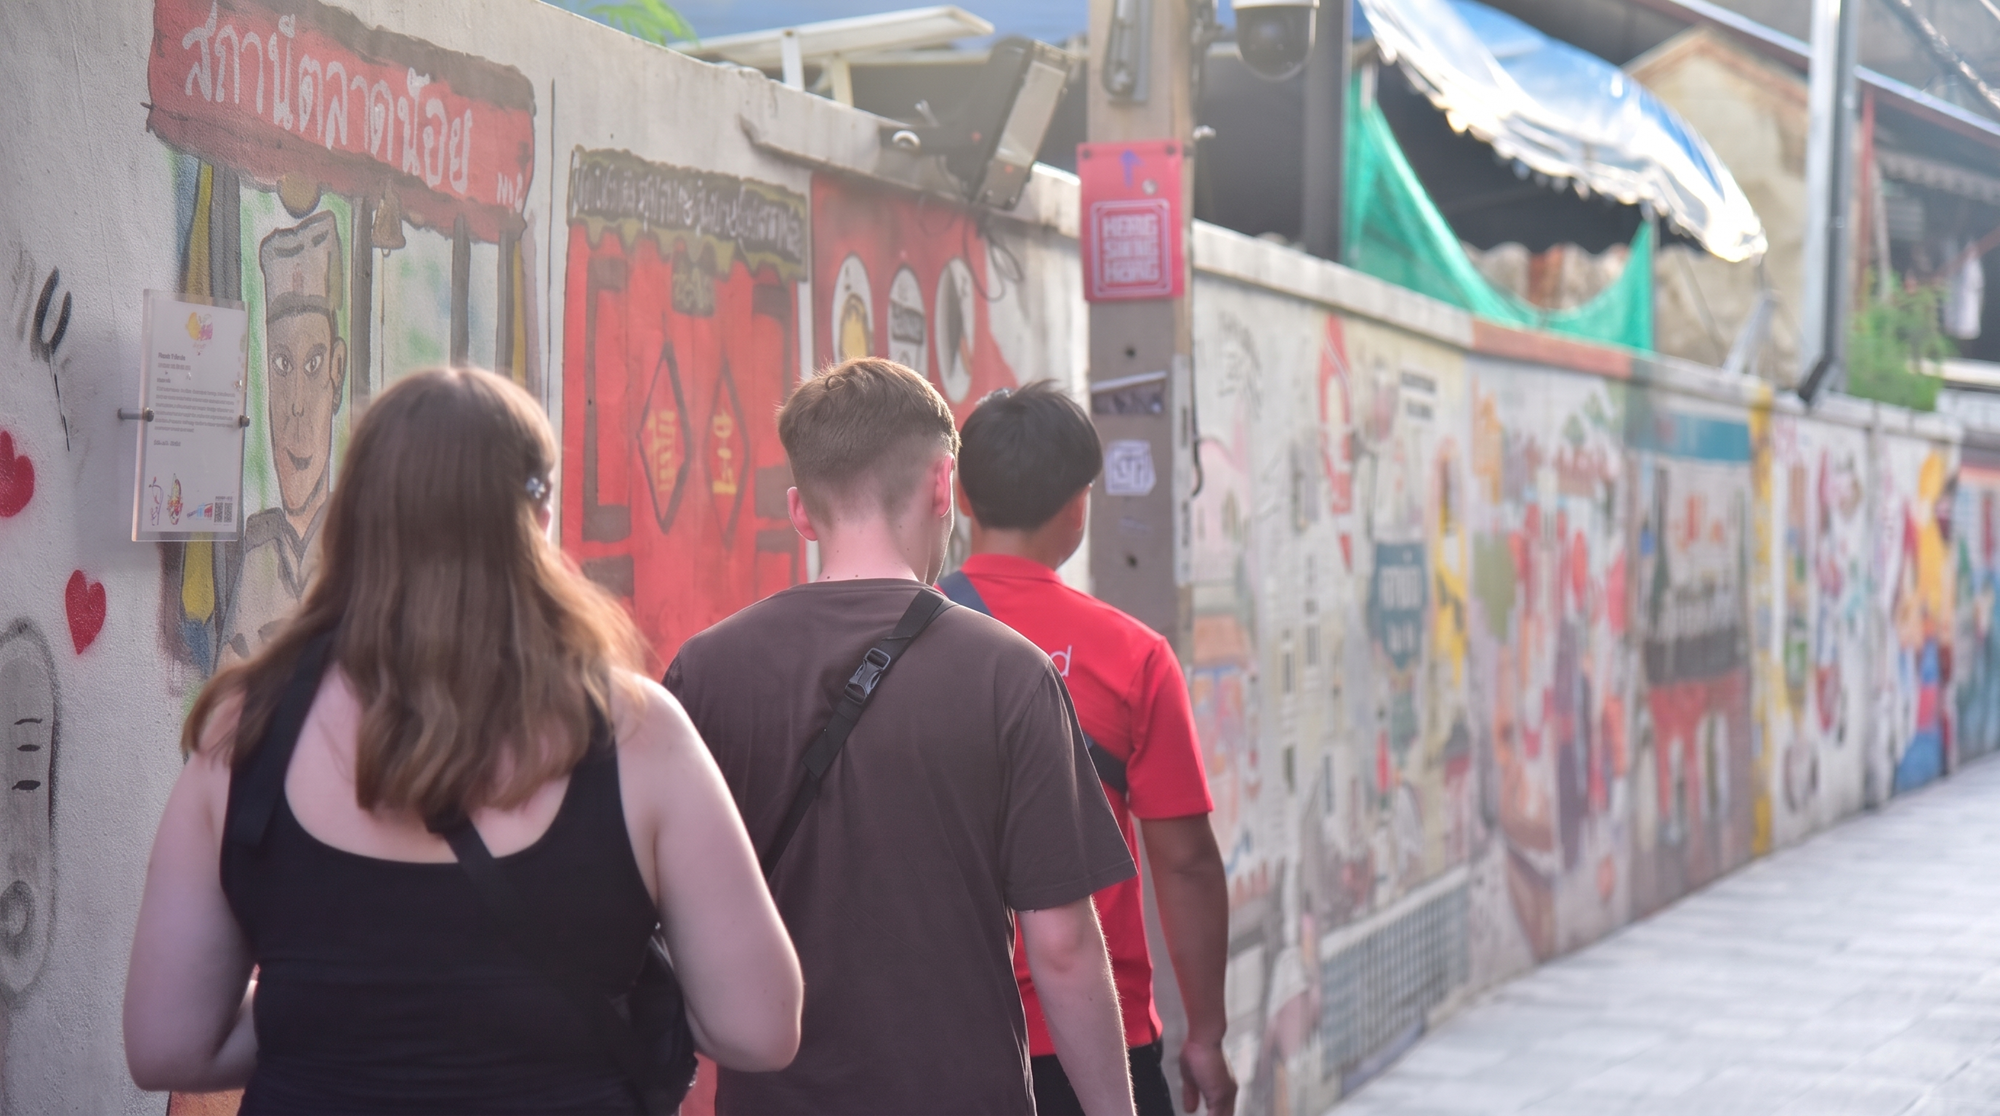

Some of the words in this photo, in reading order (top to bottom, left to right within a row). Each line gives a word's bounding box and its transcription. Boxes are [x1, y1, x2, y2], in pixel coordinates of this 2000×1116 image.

[182, 0, 473, 195] สถานีตลาดน้อย
